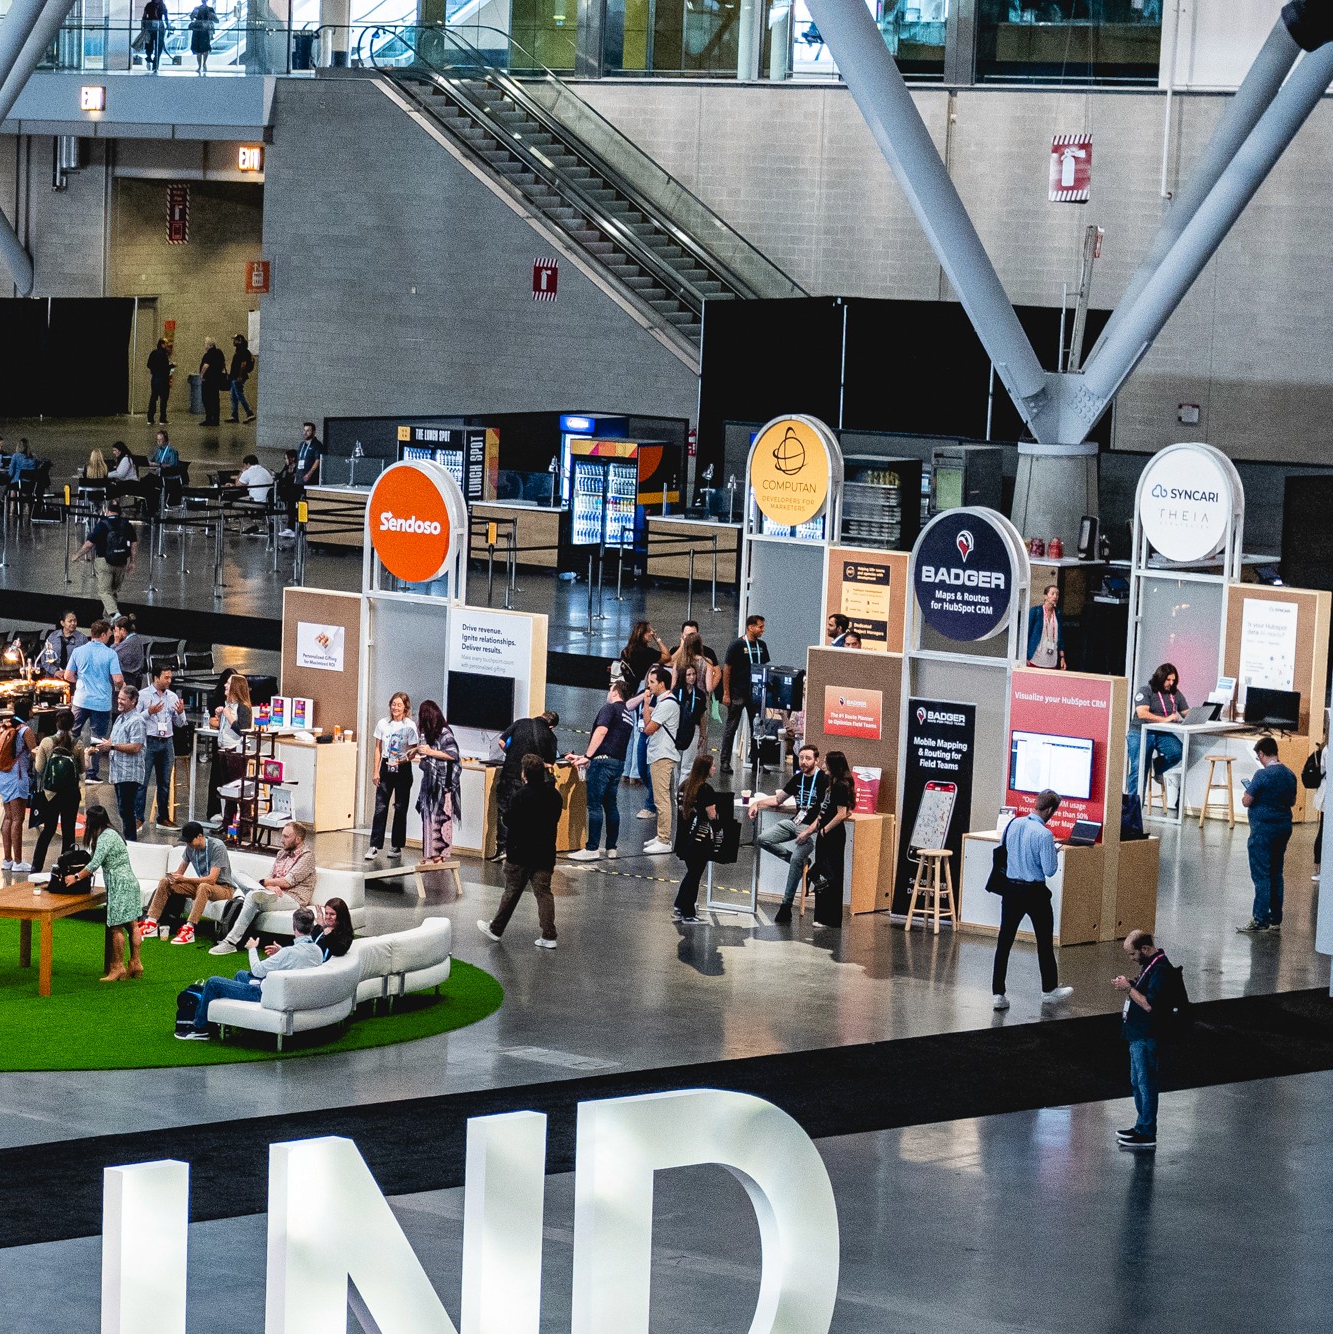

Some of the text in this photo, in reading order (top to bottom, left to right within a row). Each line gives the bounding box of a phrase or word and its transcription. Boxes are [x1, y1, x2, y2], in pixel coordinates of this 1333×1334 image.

[439, 430, 451, 442] SPOT
[468, 436, 484, 497] LUNCH SPOT
[762, 479, 817, 494] COMPUTAN
[762, 495, 801, 505] DEVELOPERS
[1170, 488, 1219, 503] SYNCARI
[770, 503, 806, 512] MARKETERS
[1160, 508, 1209, 523] THEIA
[379, 510, 441, 535] Sendoso
[921, 565, 1005, 589] BADGER
[935, 590, 990, 603] Maps & Routes
[930, 600, 993, 615] for HubSpot CRM
[462, 623, 503, 635] Drive revenue.
[461, 633, 516, 648] Ignite relationships.
[461, 643, 503, 654] Deliver results.
[1014, 690, 1107, 709] Visualize your HubSpot CRM
[927, 710, 966, 723] BADGER
[913, 736, 968, 752] Mobile Mapping
[918, 747, 962, 760] & Routing for
[919, 758, 959, 771] Field Teams
[1070, 801, 1087, 810] usage
[1062, 810, 1076, 819] than
[1076, 812, 1089, 820] 50%
